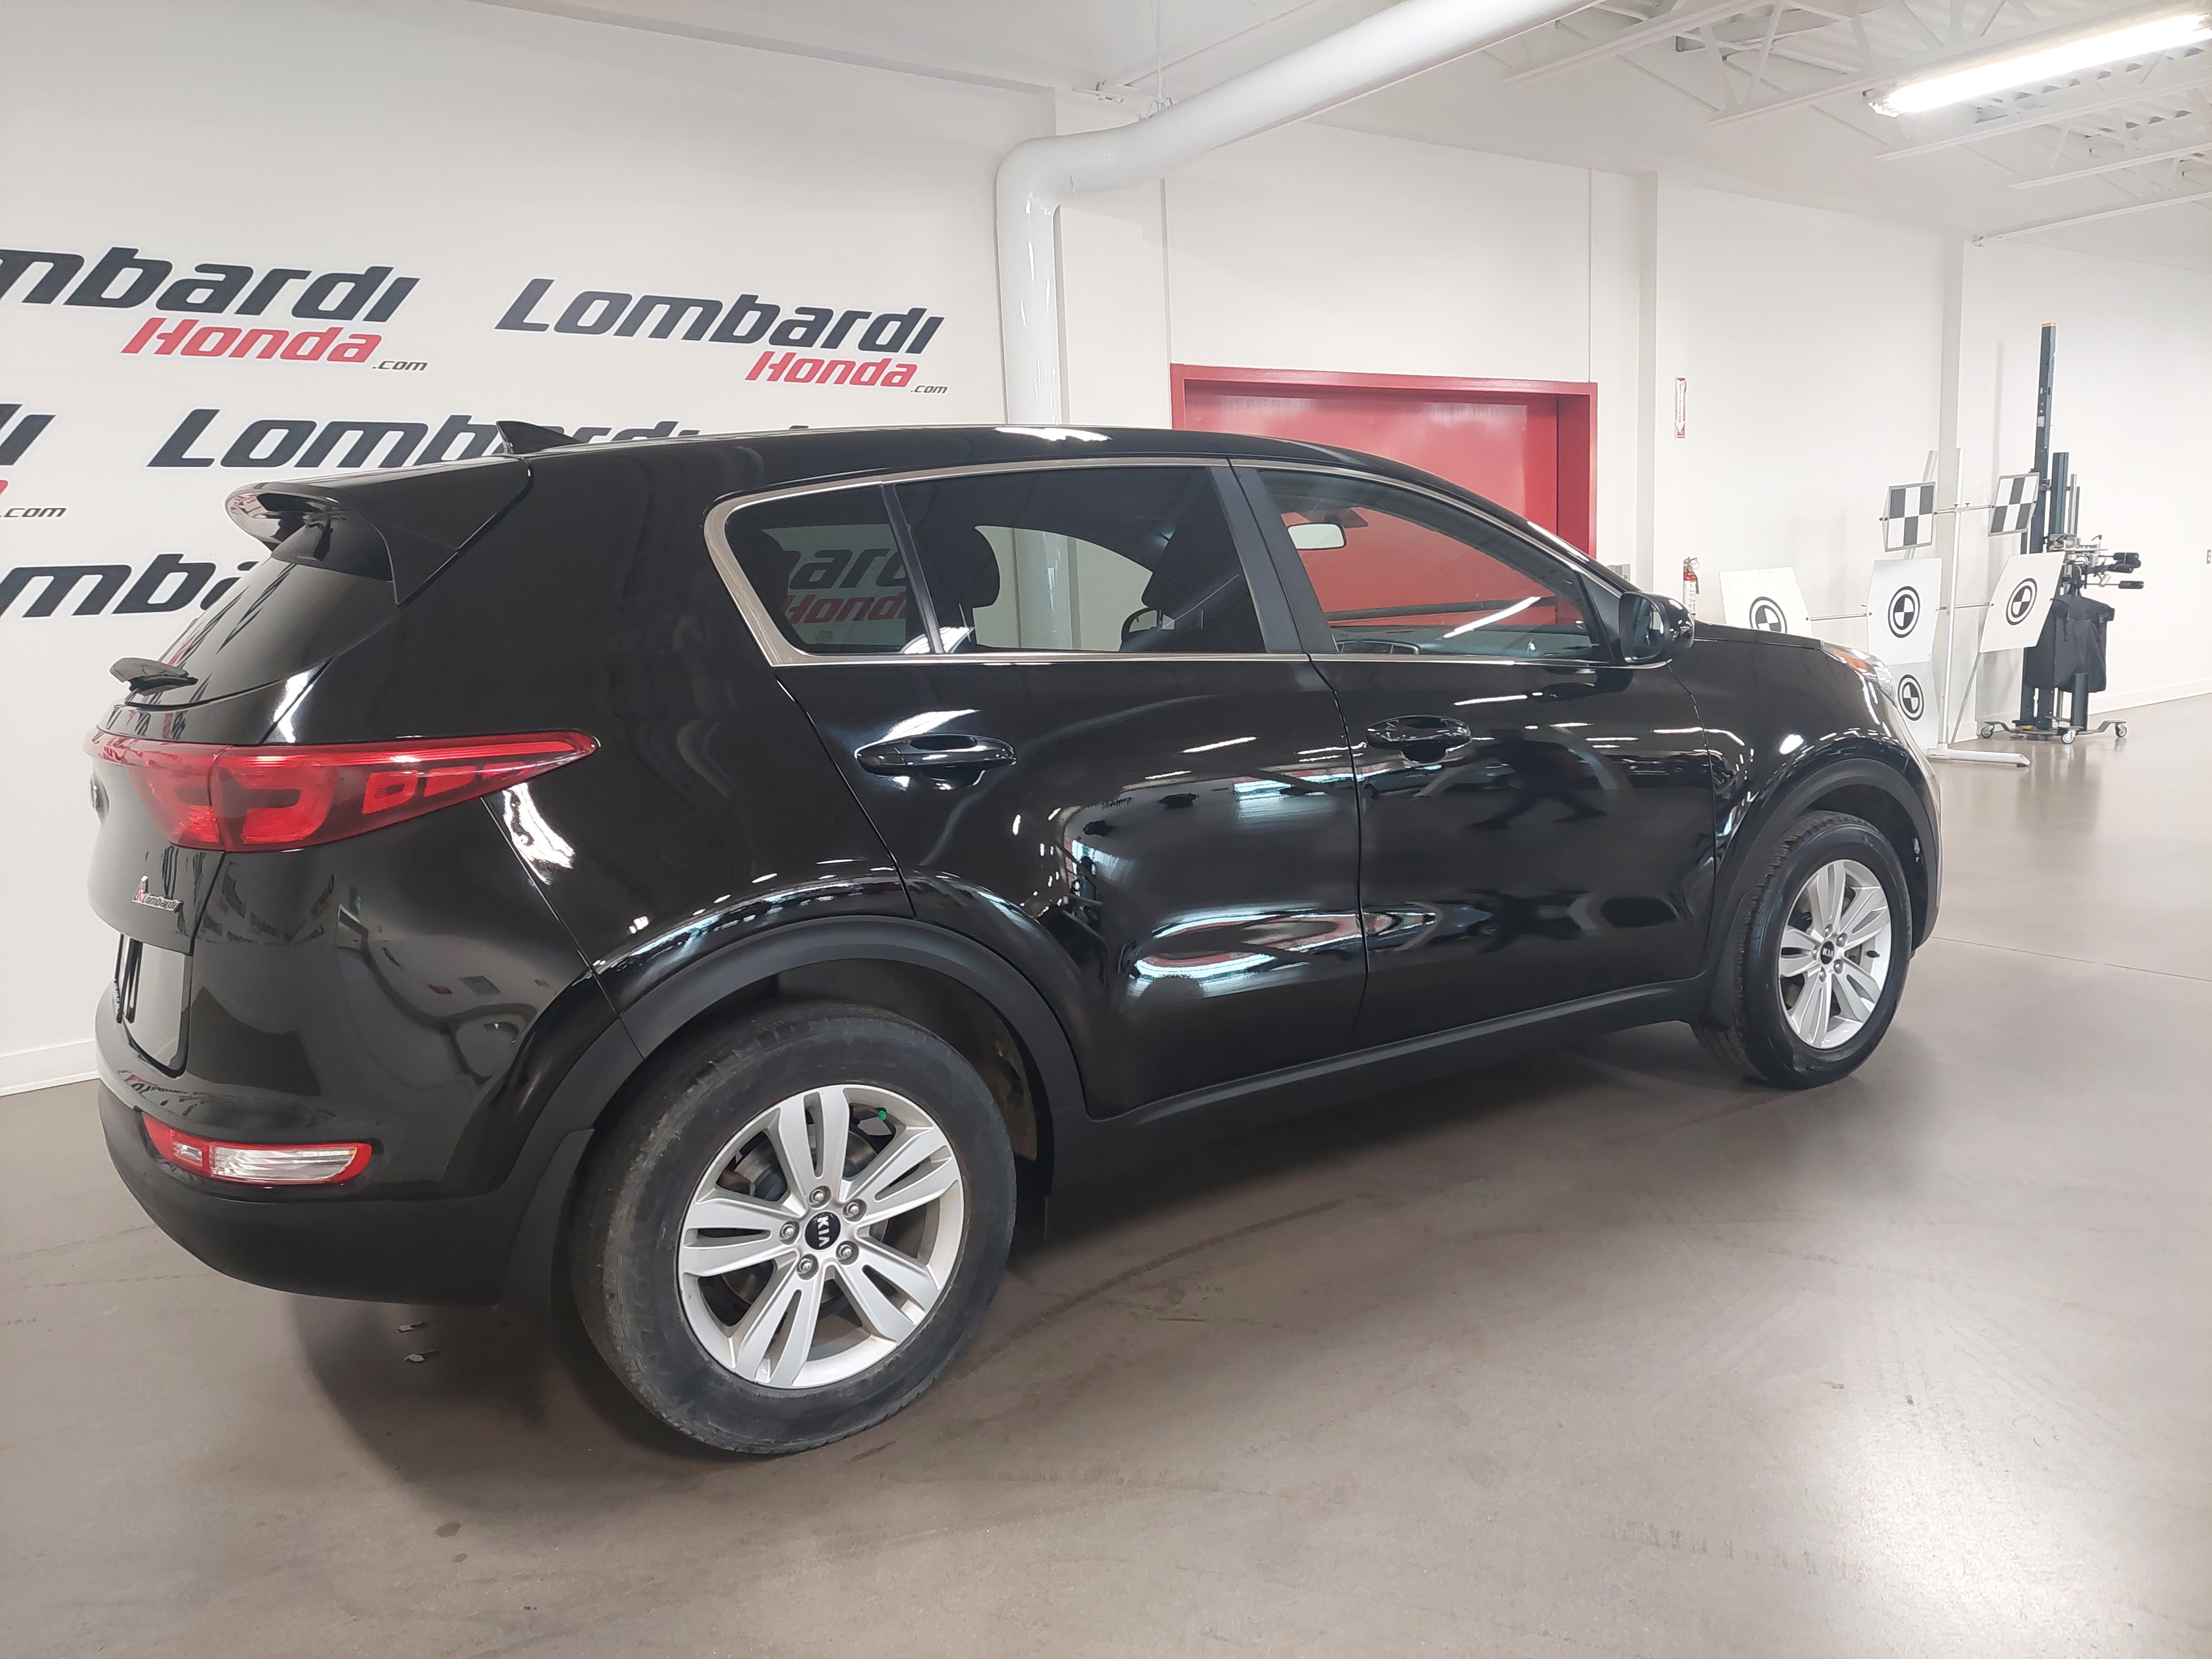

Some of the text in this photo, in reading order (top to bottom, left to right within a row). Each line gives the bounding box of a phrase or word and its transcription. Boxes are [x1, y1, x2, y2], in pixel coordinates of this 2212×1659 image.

[494, 278, 945, 354] Lombardi
[121, 317, 382, 363] Honda
[372, 360, 428, 371] .com
[745, 351, 918, 387] Honda
[910, 385, 948, 394] .com
[781, 591, 907, 624] Hond
[142, 894, 177, 909] Lombardi
[1822, 947, 1834, 958] KIA
[817, 1215, 830, 1248] KIA
